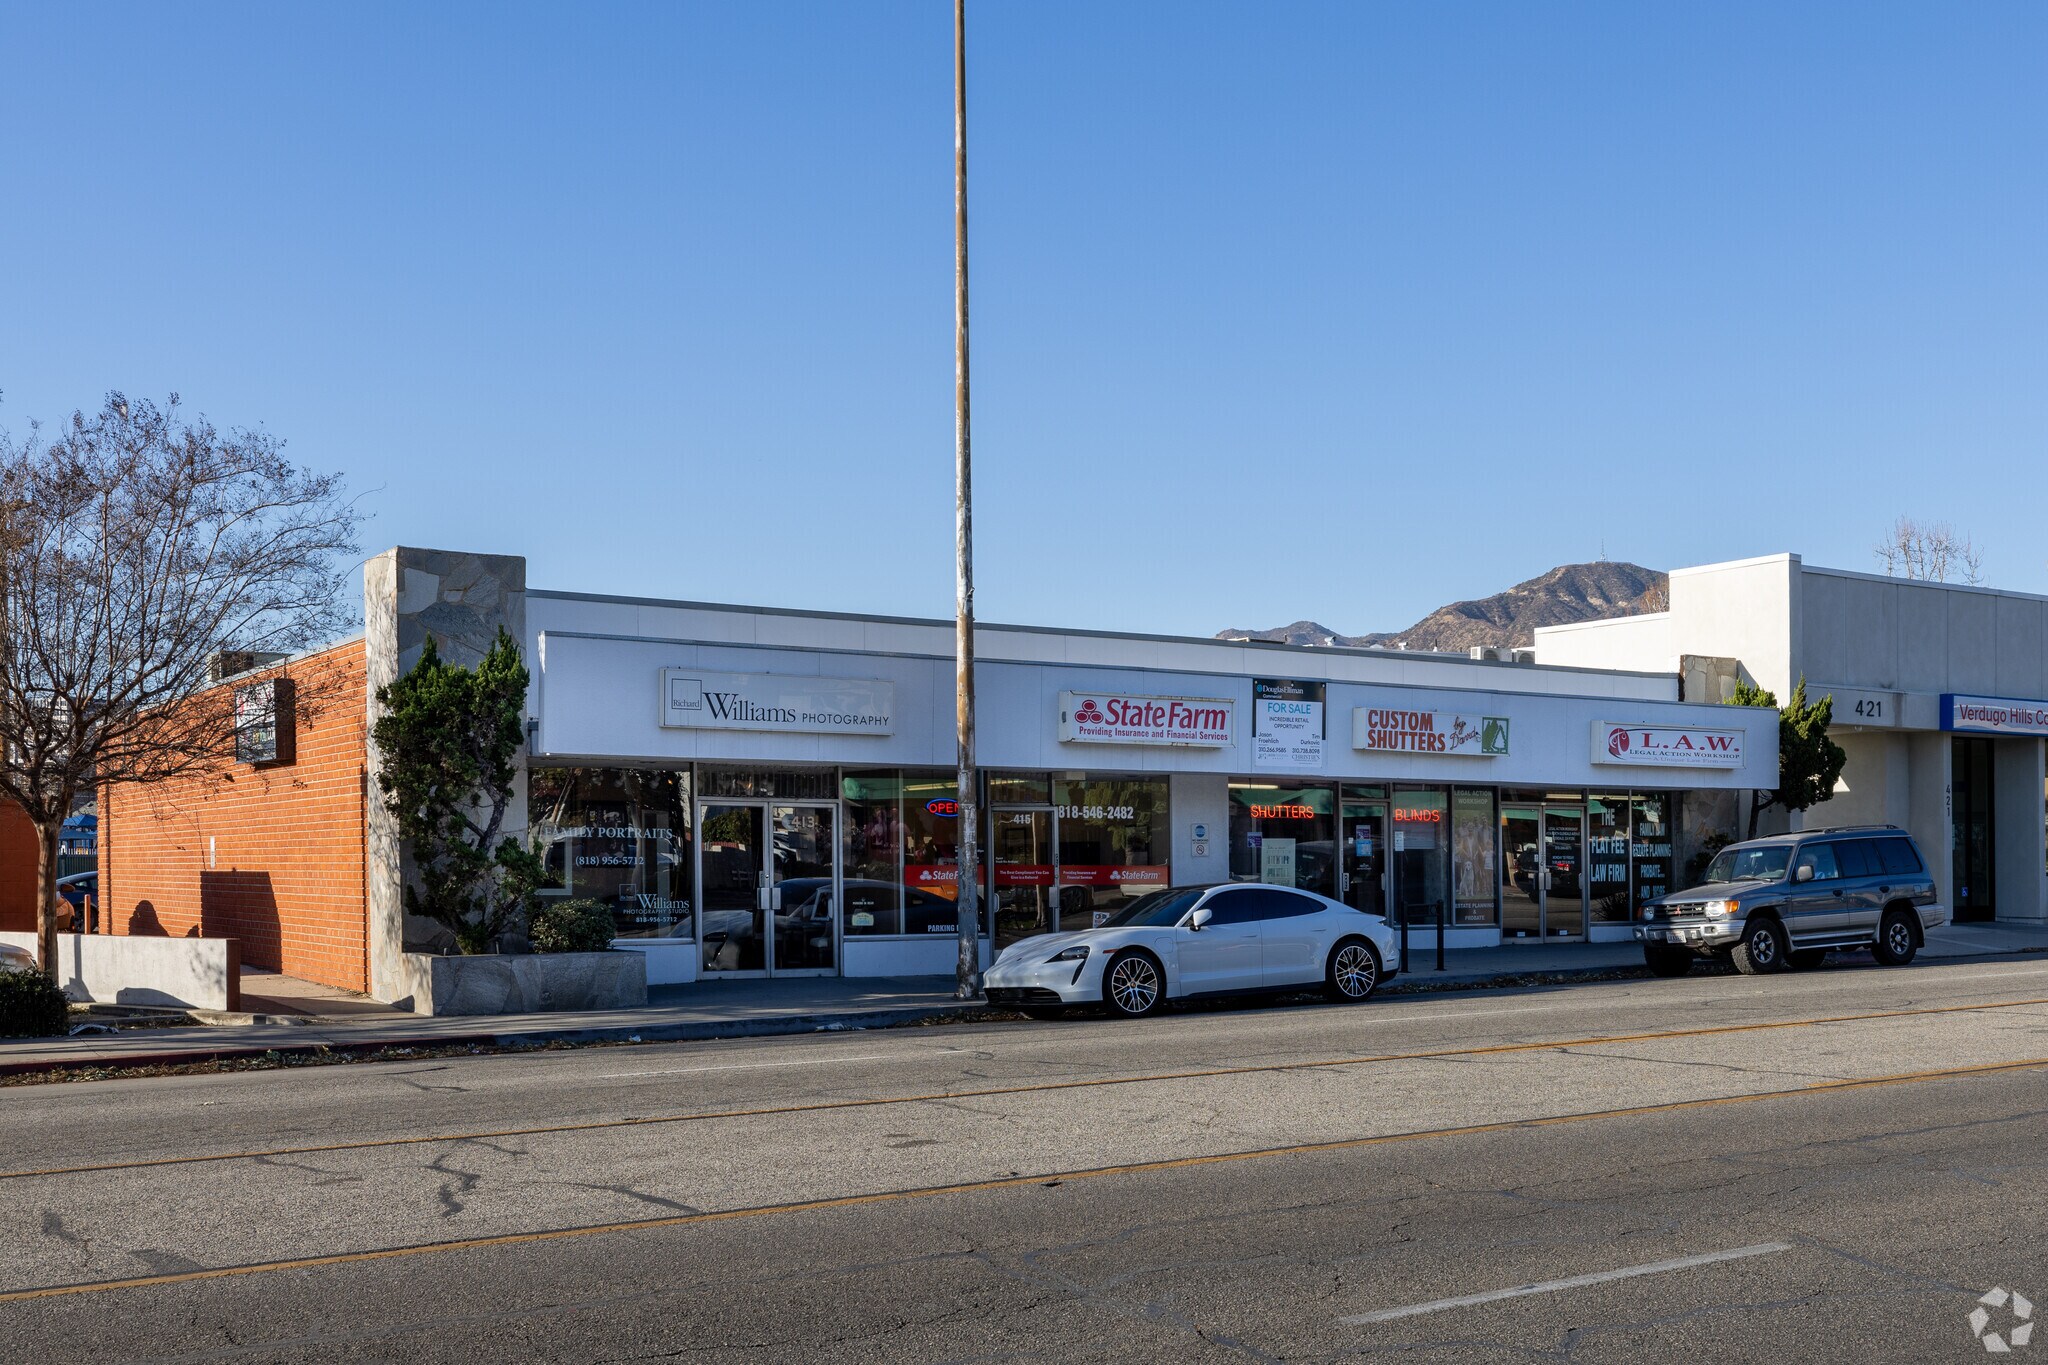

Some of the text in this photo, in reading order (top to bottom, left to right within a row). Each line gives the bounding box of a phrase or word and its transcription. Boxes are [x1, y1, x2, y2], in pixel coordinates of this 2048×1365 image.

[673, 699, 700, 708] Richard
[702, 692, 889, 726] Williams PHOTOGRAPHY
[1268, 702, 1312, 714] FOR SALE
[1855, 699, 1881, 718] 421
[1368, 709, 1434, 732] CUSTOM
[1960, 704, 2006, 726] Verdugo
[2010, 708, 2032, 724] Hills
[1079, 726, 1228, 741] Providing Insurance and Financial Services
[1368, 729, 1446, 751] SHUTTERS
[1641, 732, 1740, 752] L.A.W.
[1013, 814, 1031, 824] 415
[1058, 805, 1134, 819] 818-546-2482
[1250, 805, 1314, 819] SHUTTERS
[1395, 809, 1440, 822] BLINDS
[1602, 808, 1615, 826] THE
[792, 816, 815, 828] 413
[545, 827, 673, 839] FAMILY PORTRAITS
[1640, 823, 1655, 836] FAMILY
[1591, 836, 1609, 854] FLAT
[1611, 838, 1625, 854] FEE
[1633, 844, 1671, 857] ESTATE PLANNING
[575, 856, 645, 867] (818) 956-5712
[1591, 864, 1626, 882] LAW FIRM
[1641, 885, 1650, 899] AND
[636, 894, 690, 909] Williams
